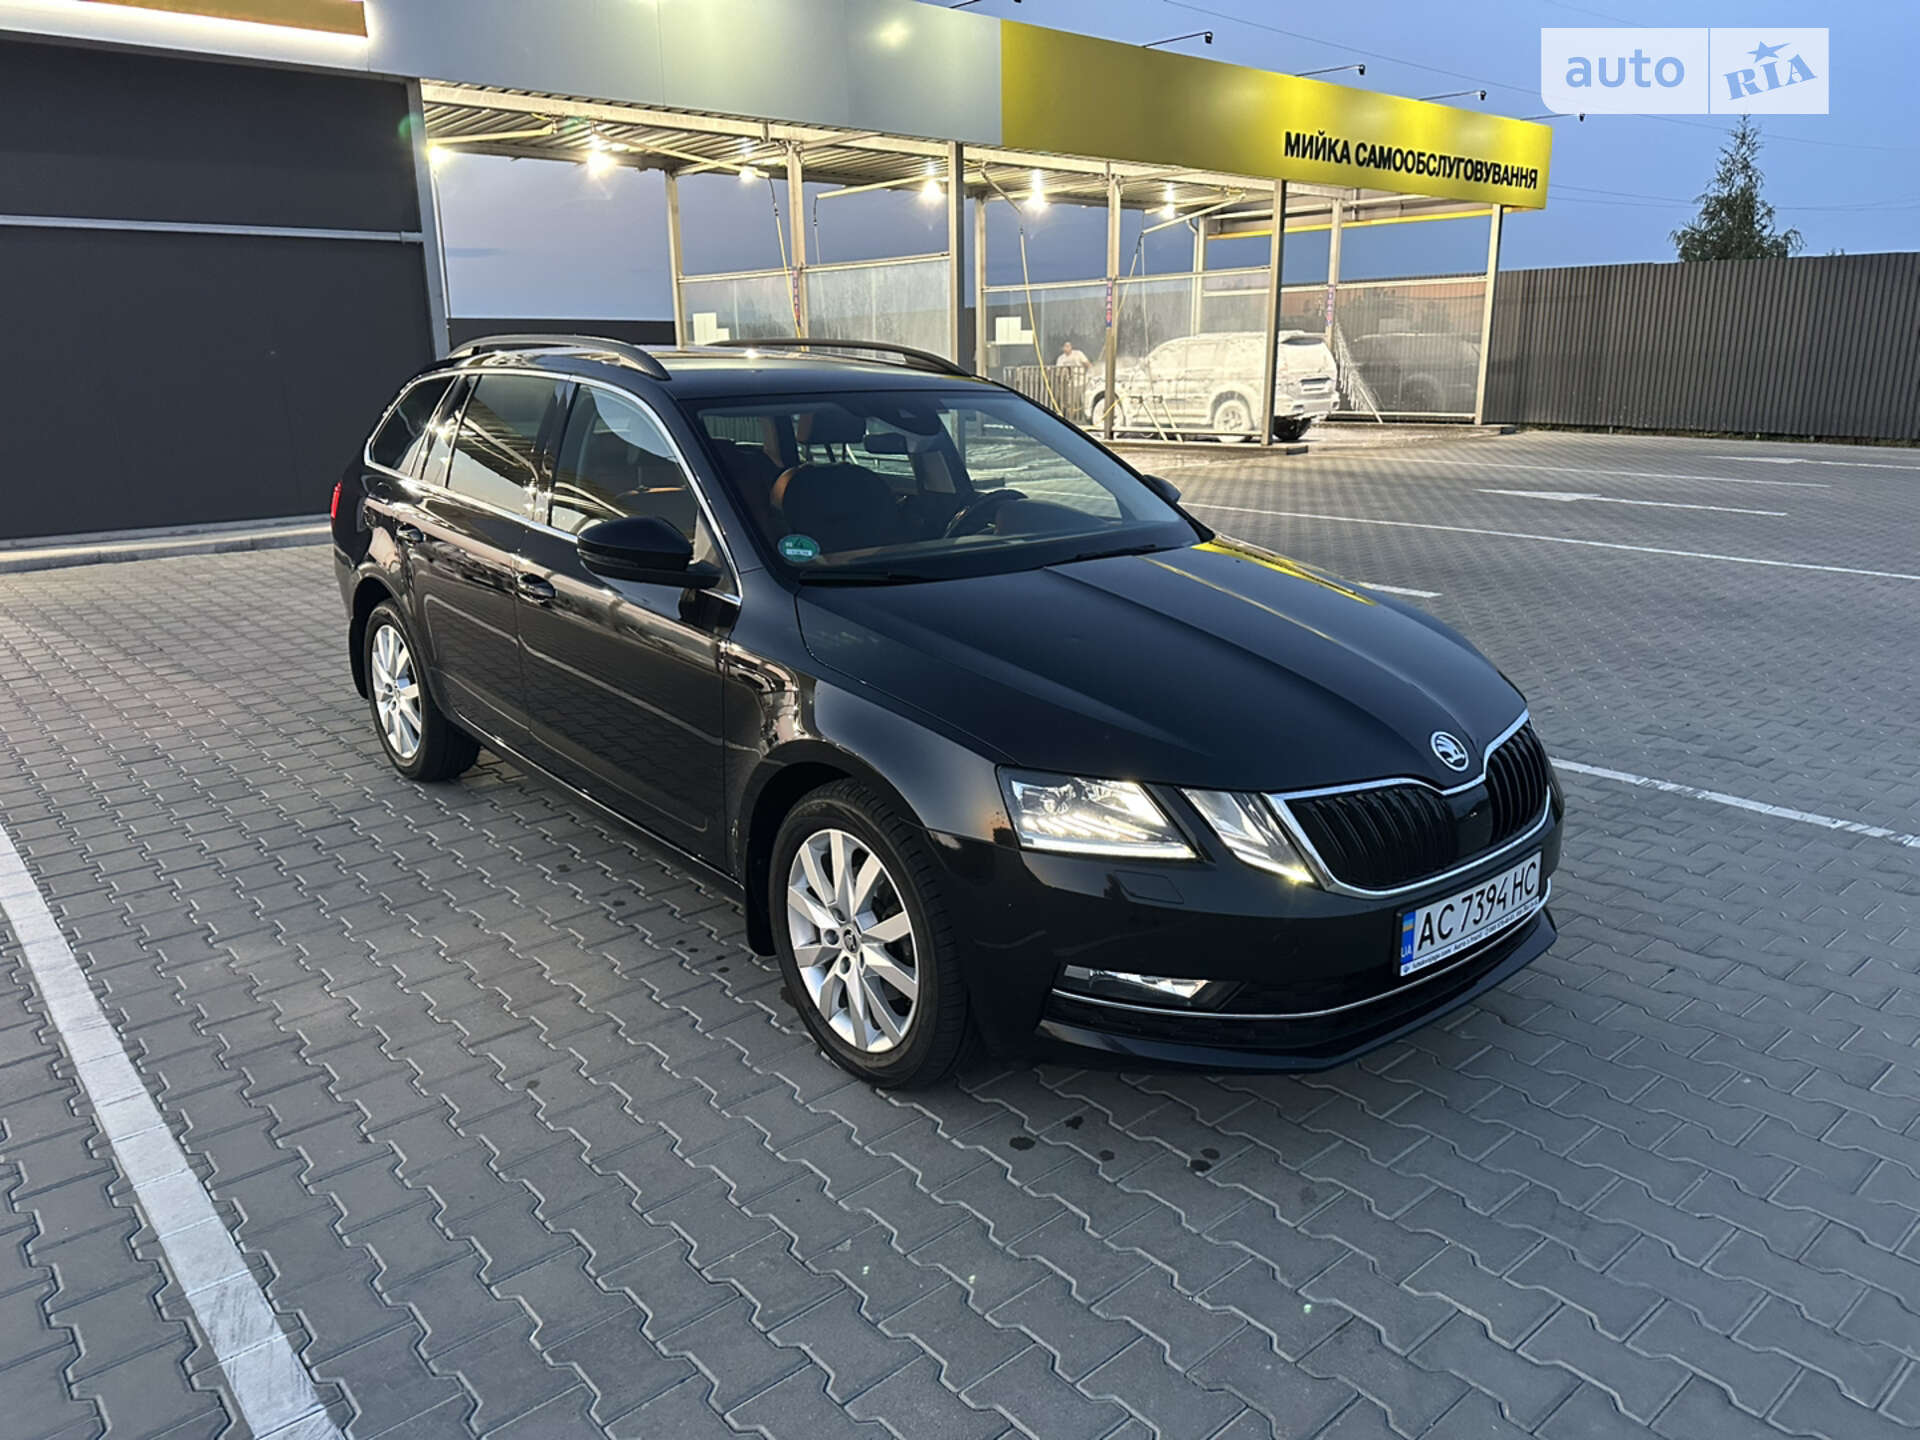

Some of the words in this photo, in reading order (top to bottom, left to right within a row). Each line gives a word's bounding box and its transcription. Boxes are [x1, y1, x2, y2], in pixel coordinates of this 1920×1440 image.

[1284, 130, 1351, 165] МИЙКА
[1354, 142, 1539, 190] САМООБСЛУГОВУВАННЯ
[1417, 903, 1455, 952] AC
[1460, 876, 1509, 933] 7394
[1511, 861, 1537, 906] HC
